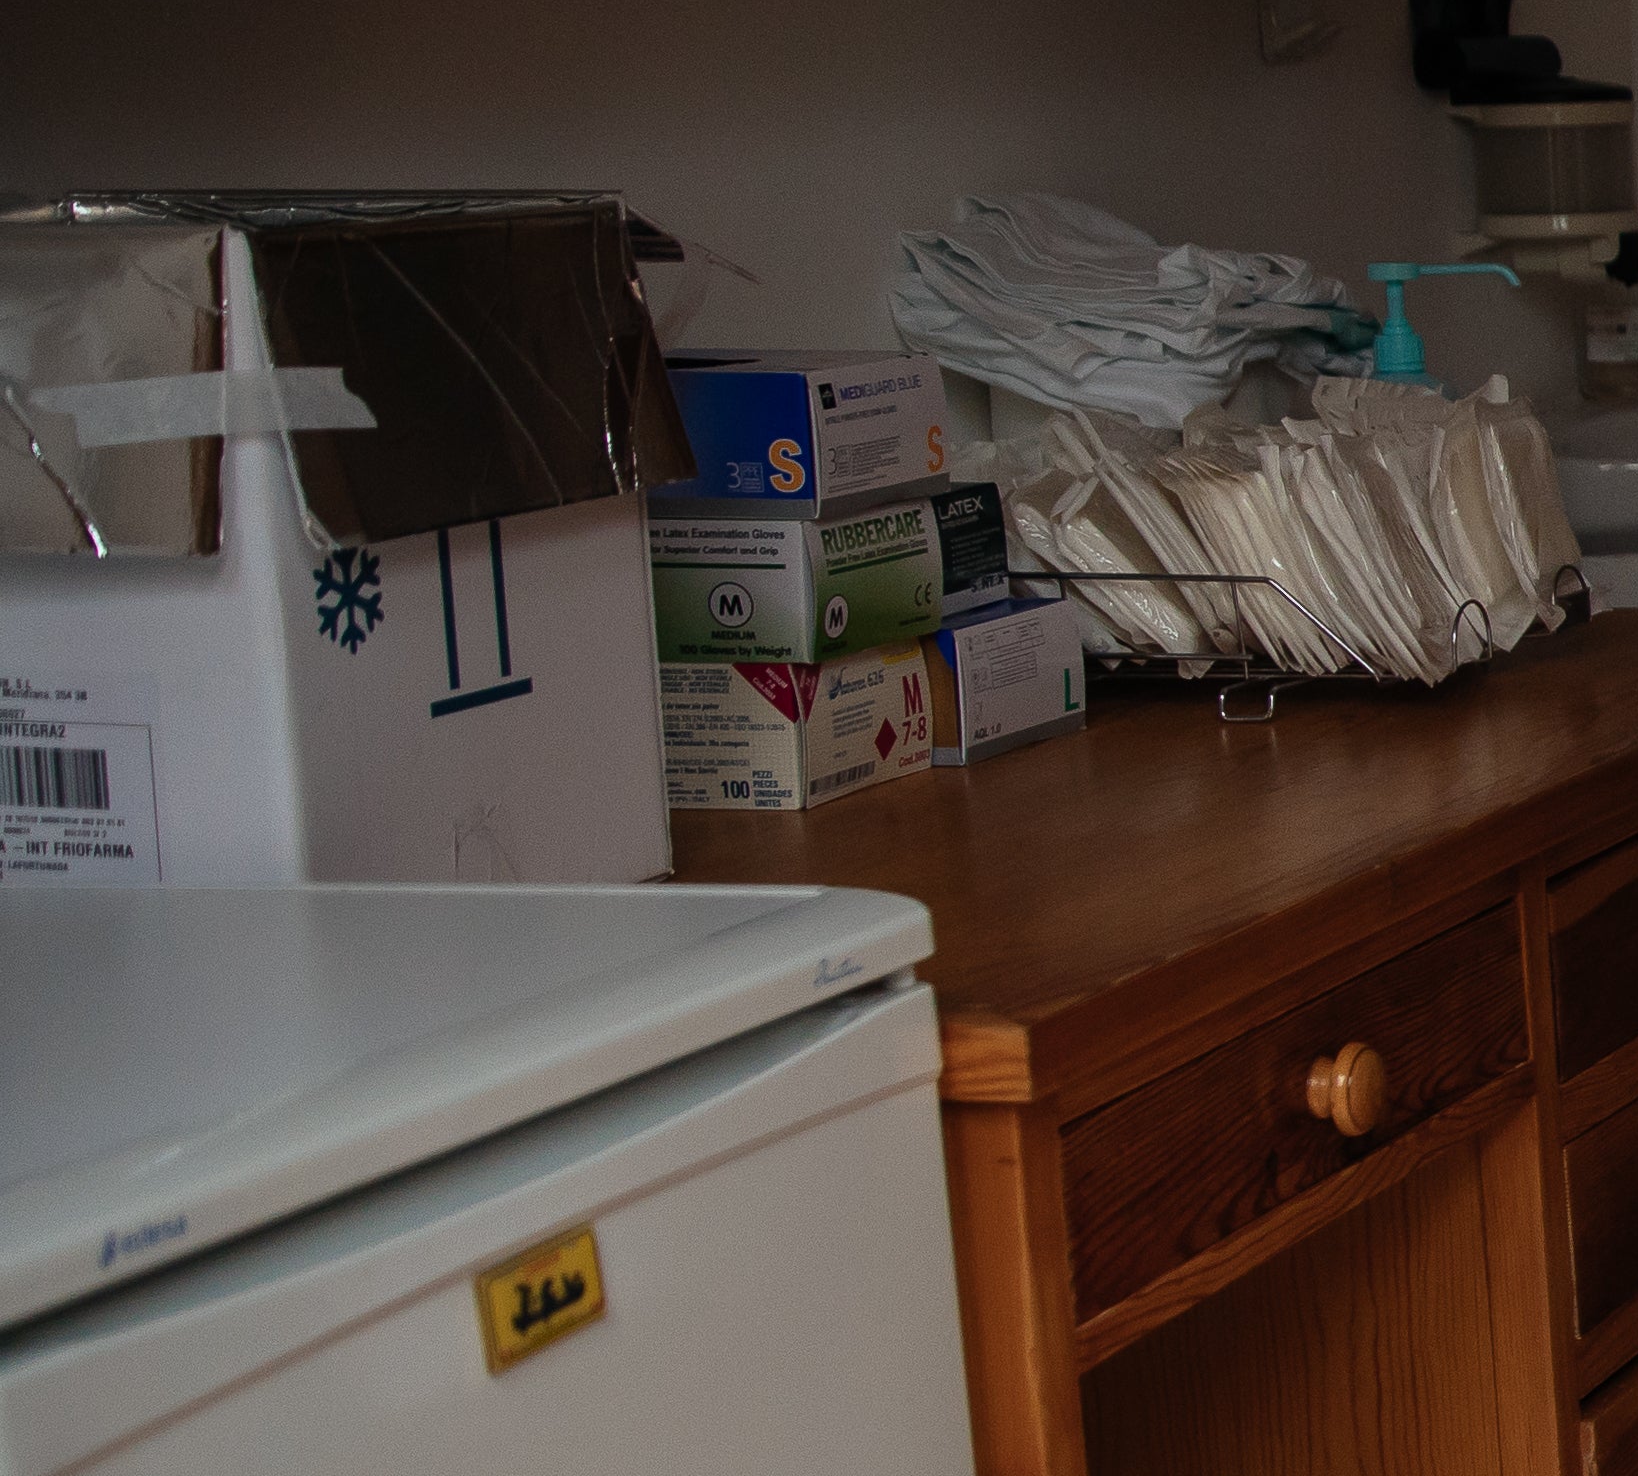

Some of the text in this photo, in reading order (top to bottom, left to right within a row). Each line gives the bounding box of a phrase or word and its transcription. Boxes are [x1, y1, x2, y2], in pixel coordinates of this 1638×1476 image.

[929, 425, 944, 473] S
[769, 438, 806, 493] S
[938, 495, 984, 521] LATEX
[663, 529, 689, 539] Latex
[691, 528, 749, 540] Examination
[752, 529, 785, 540] Gloves
[820, 509, 926, 555] RUBBERCARE
[702, 545, 738, 555] Comfort
[740, 546, 757, 555] and
[759, 546, 779, 557] Grip
[720, 594, 744, 616] M
[829, 605, 844, 629] M
[754, 644, 792, 658] Weight
[903, 672, 924, 718] M
[1064, 667, 1080, 712] L
[902, 716, 928, 746] 7-8
[721, 779, 751, 799] 100
[54, 842, 134, 858] FRIOFARMA
